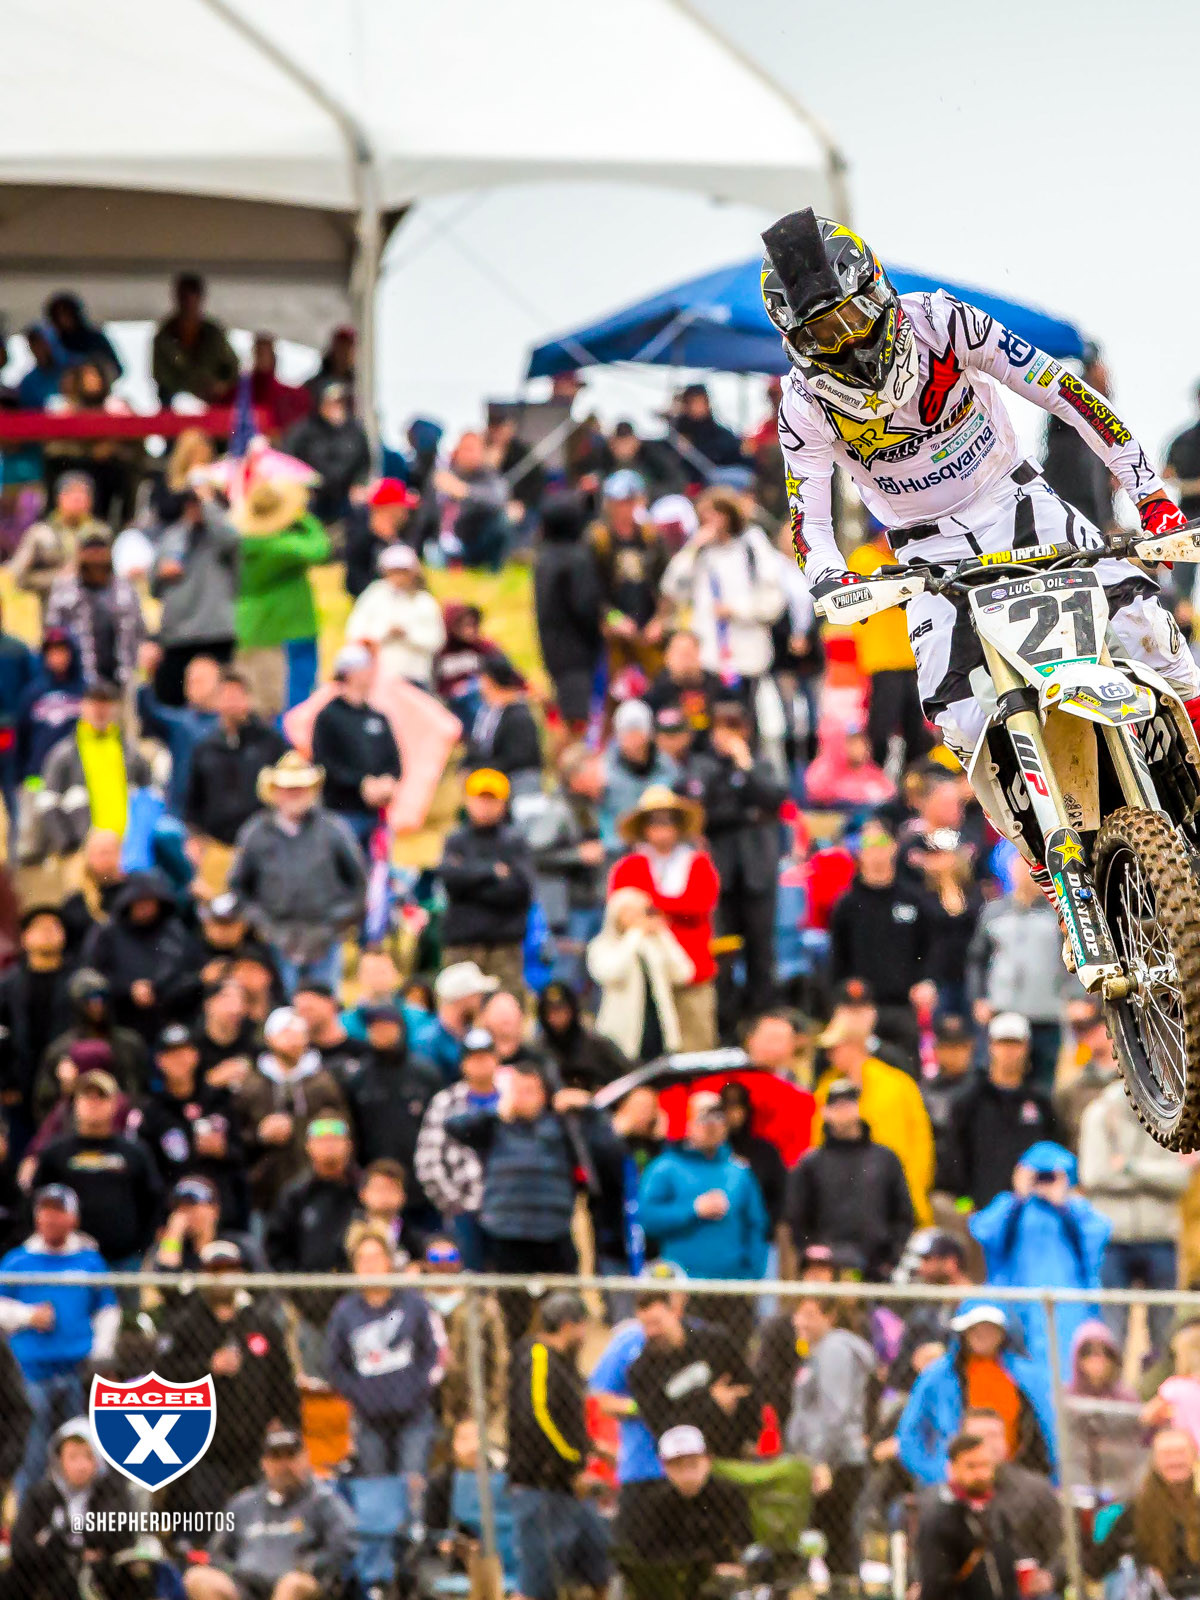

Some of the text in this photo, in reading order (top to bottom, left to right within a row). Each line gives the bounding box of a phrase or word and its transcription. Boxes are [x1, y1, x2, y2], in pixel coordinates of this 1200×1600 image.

[895, 318, 911, 354] Airoh
[824, 383, 861, 407] Husqvarna
[1060, 387, 1116, 445] ENERGY DRINK
[946, 413, 984, 454] MOTOREX
[900, 425, 993, 493] Husqvarna
[960, 437, 997, 480] FACTORY RACING
[979, 544, 1051, 566] PROTAPER
[836, 588, 870, 606] PROTAPER
[1047, 578, 1065, 588] OIL
[1008, 590, 1097, 665] 21
[1060, 896, 1085, 966] MOTOREX
[1067, 872, 1099, 956] DUNLOP
